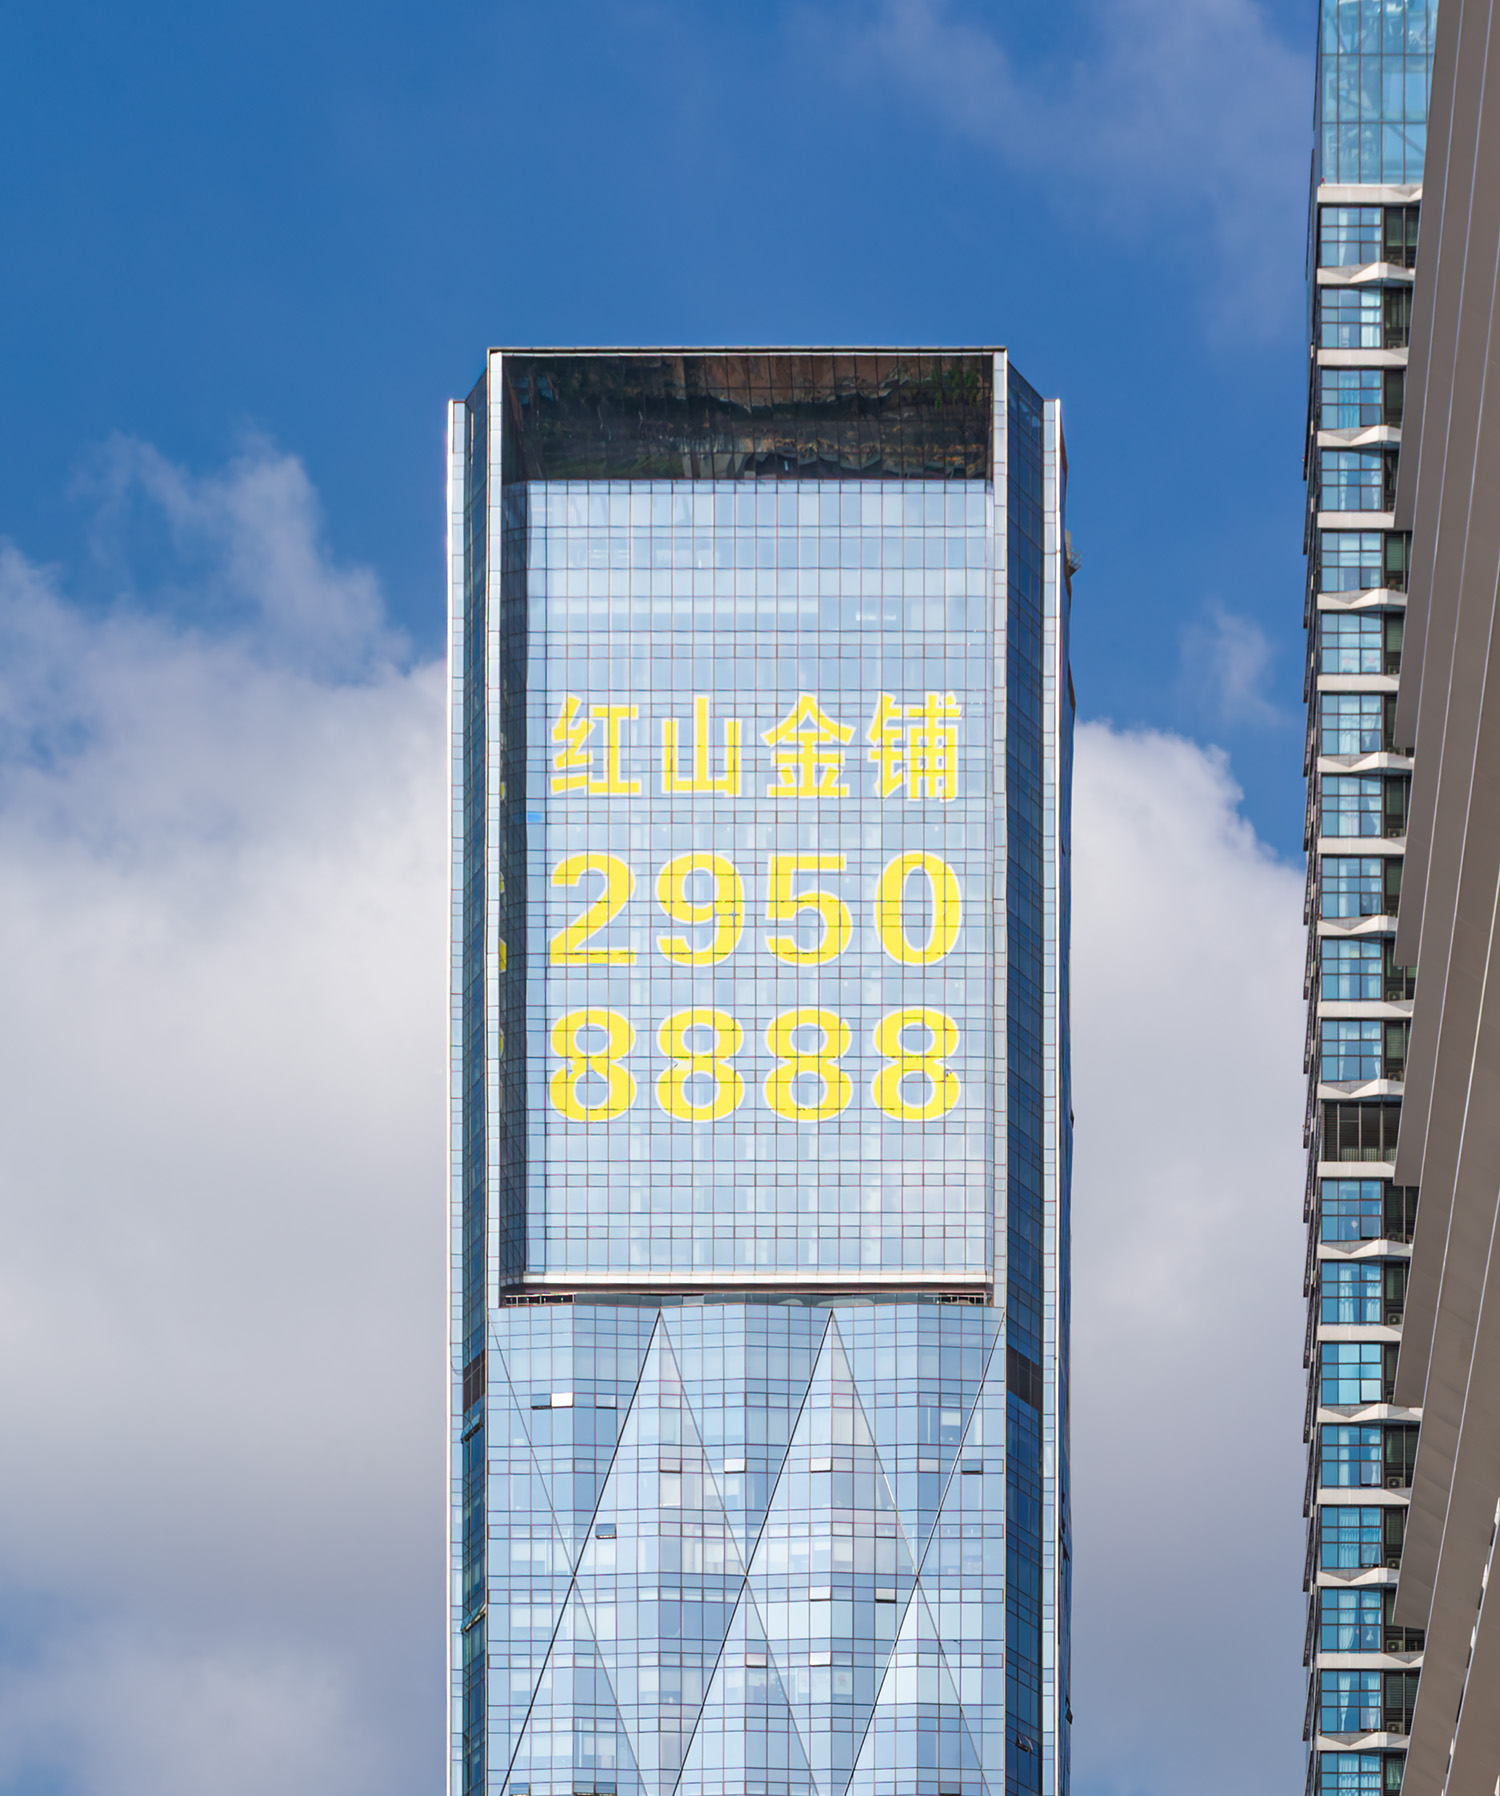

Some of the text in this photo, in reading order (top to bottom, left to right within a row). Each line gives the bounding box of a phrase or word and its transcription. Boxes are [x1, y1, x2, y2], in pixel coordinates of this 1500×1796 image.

[551, 694, 961, 802] 红山金铺
[549, 853, 961, 966] 2950
[549, 1009, 961, 1122] 8888
